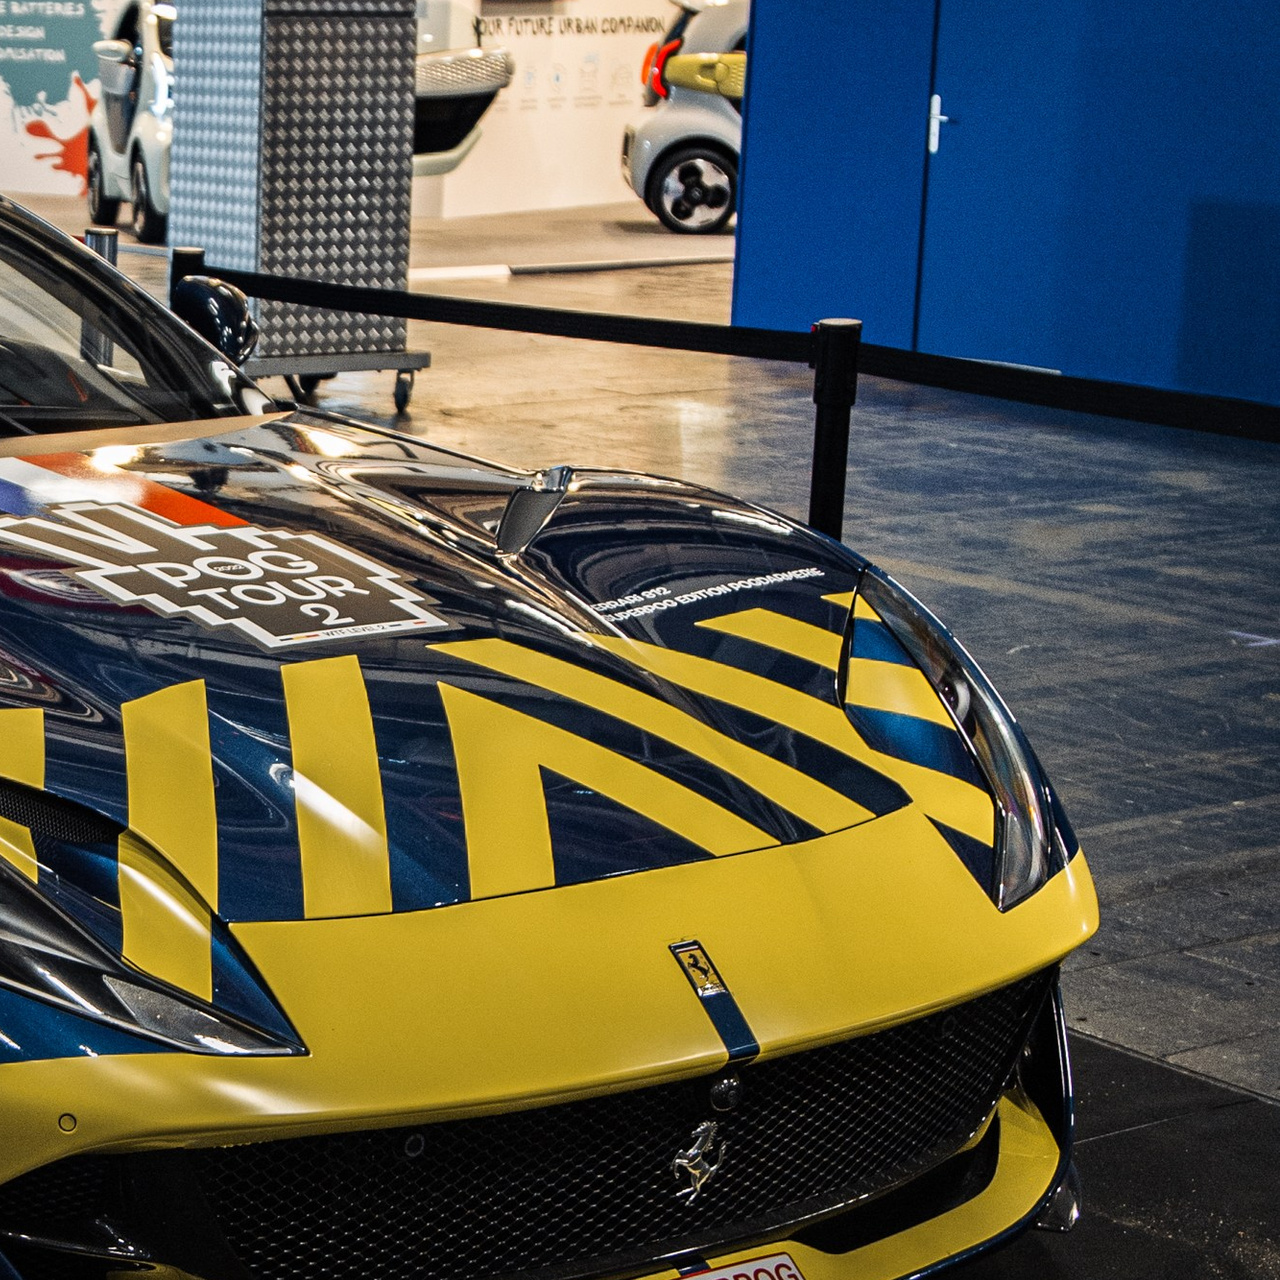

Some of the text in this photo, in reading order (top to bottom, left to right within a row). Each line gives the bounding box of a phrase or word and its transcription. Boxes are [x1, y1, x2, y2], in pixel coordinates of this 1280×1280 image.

[10, 1, 86, 17] BATTERIES
[508, 15, 554, 36] FUTURE
[559, 17, 599, 36] URBAN
[601, 16, 666, 35] COMPANION
[137, 550, 319, 588] POG
[188, 575, 370, 610] TOUR
[674, 584, 732, 606] EDITION
[727, 567, 826, 592] POGDARMERIE
[590, 593, 645, 612] ERRARI
[299, 603, 356, 626] 2
